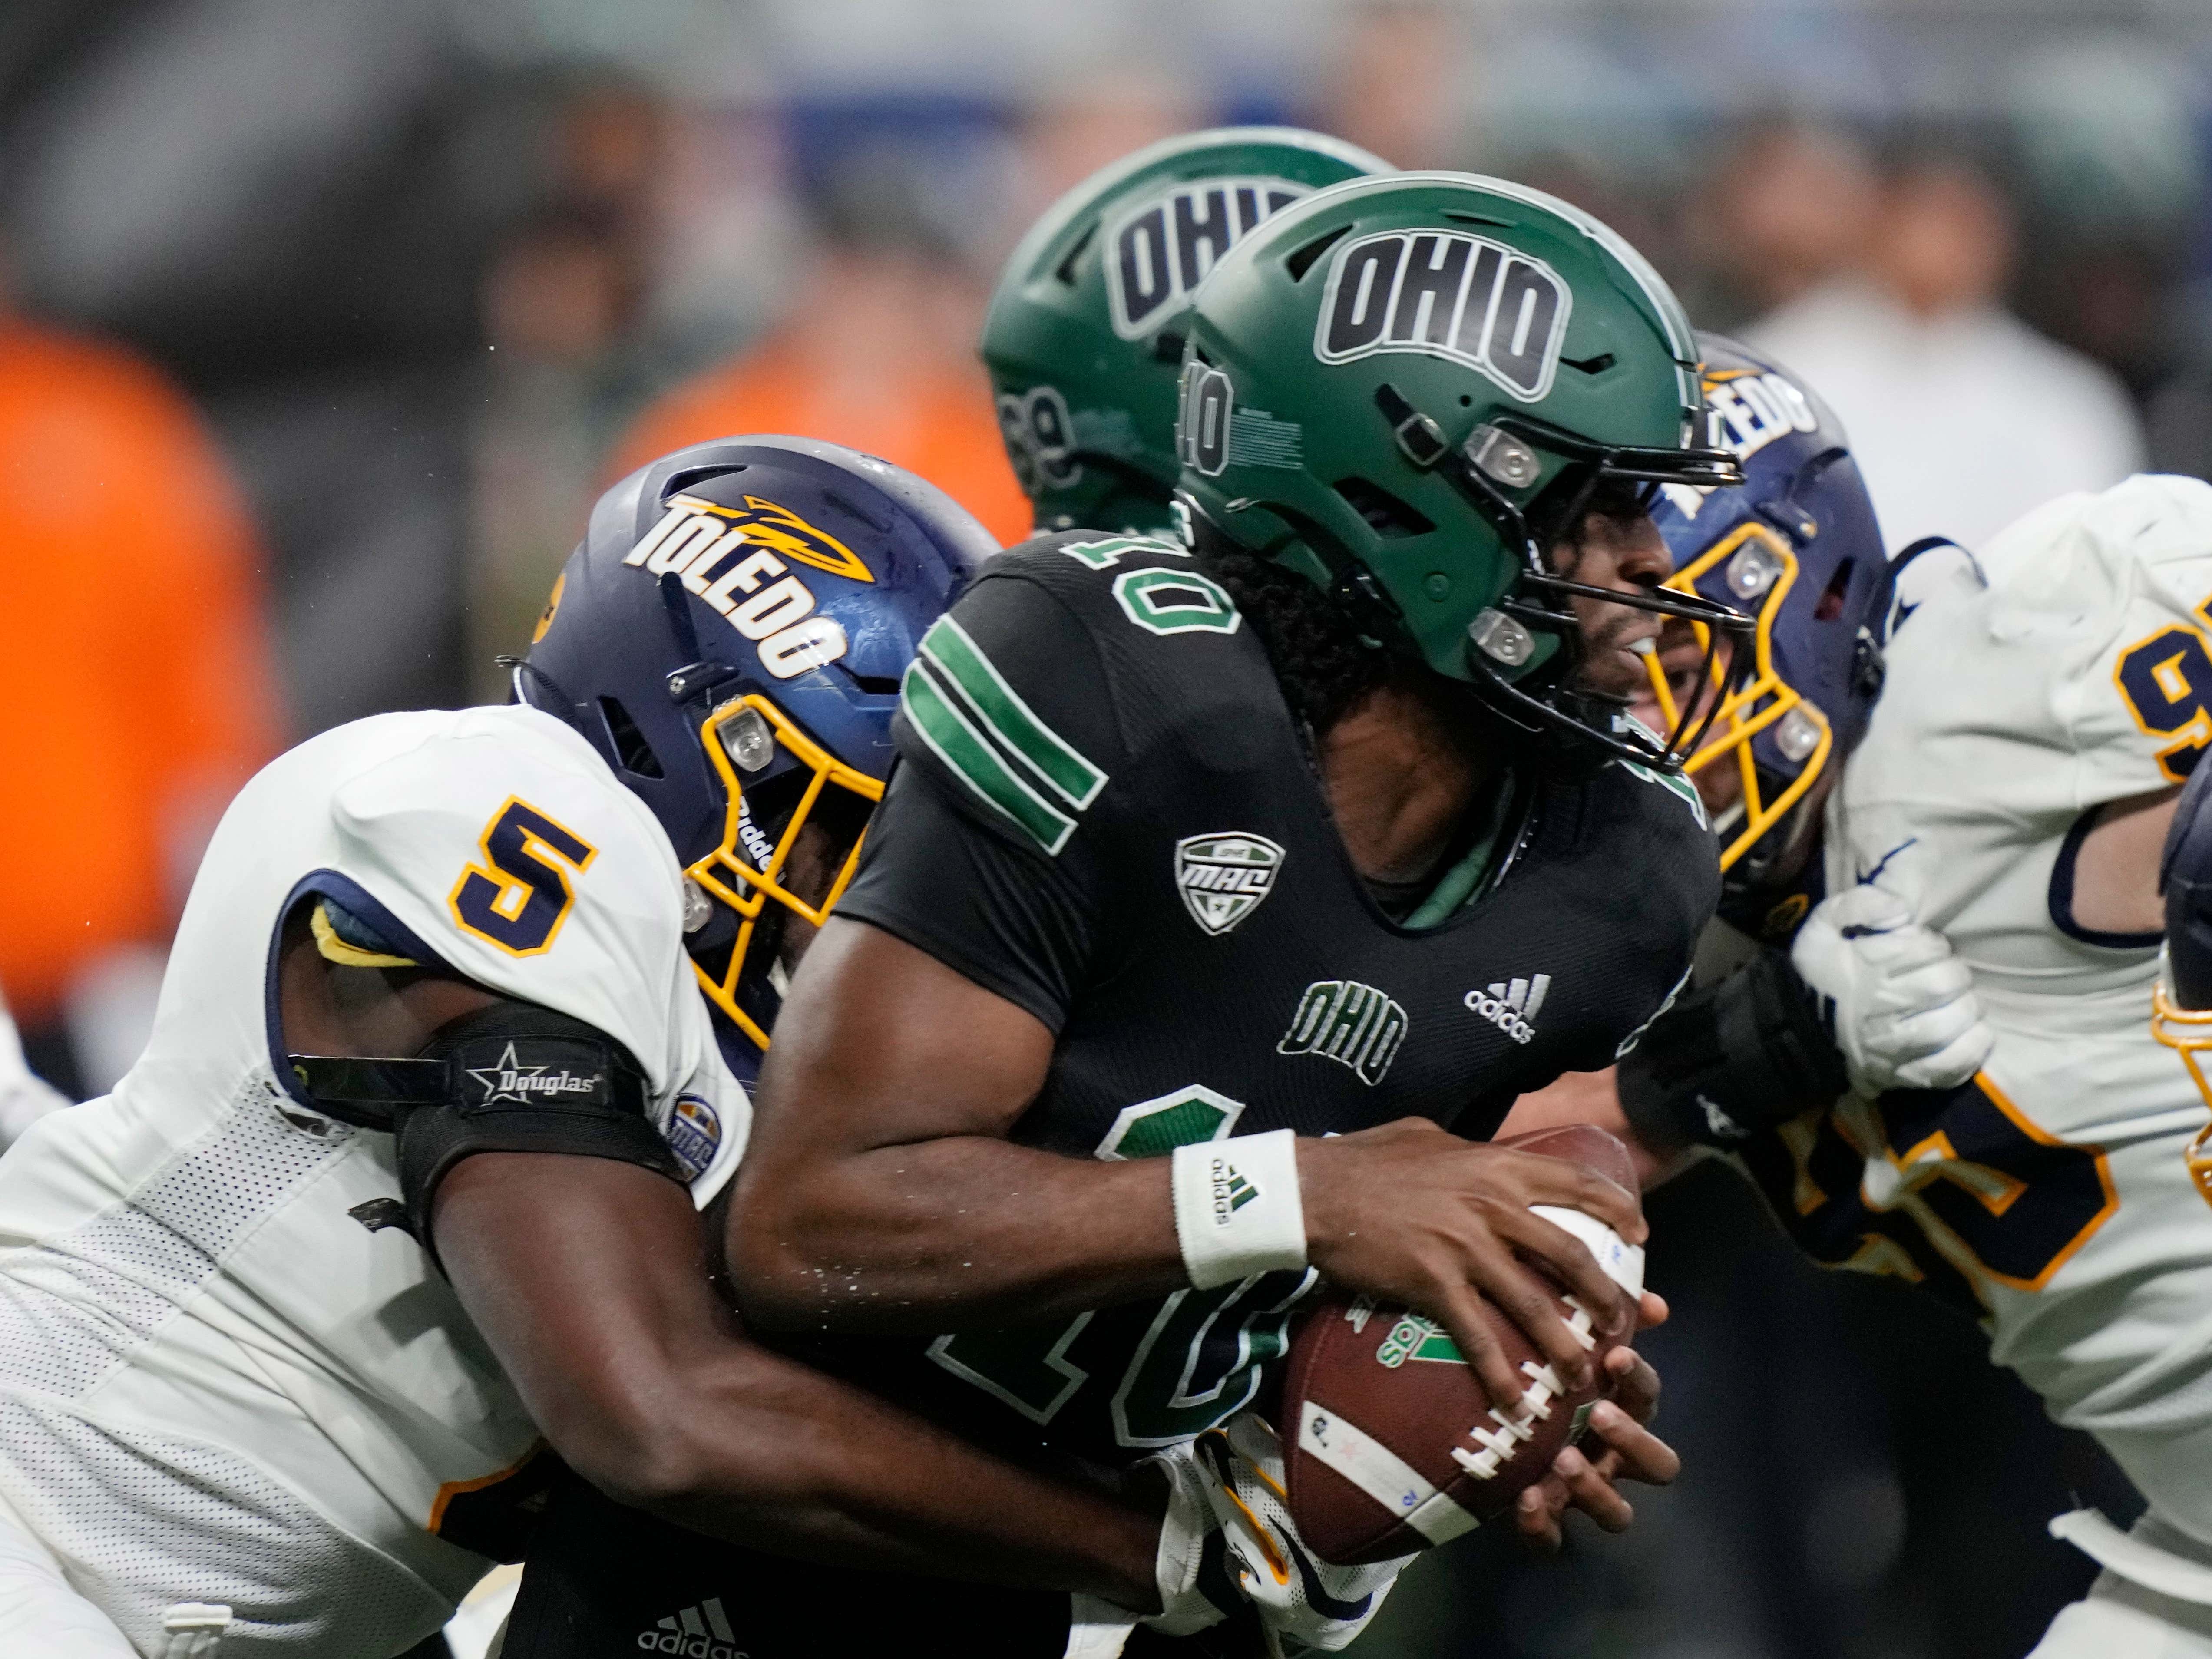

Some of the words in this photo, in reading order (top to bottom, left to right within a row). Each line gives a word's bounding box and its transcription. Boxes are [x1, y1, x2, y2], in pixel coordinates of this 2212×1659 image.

[1104, 176, 1316, 340] OH
[1313, 228, 1573, 403] OHIO
[623, 493, 847, 679] TOLEDO
[1058, 537, 1242, 635] 10
[448, 794, 599, 958] 5
[1177, 863, 1272, 891] MAC
[1276, 980, 1409, 1086] OHIO
[1464, 990, 1536, 1044] adidas
[497, 1070, 595, 1095] Douglas
[1212, 1159, 1230, 1225] adidas
